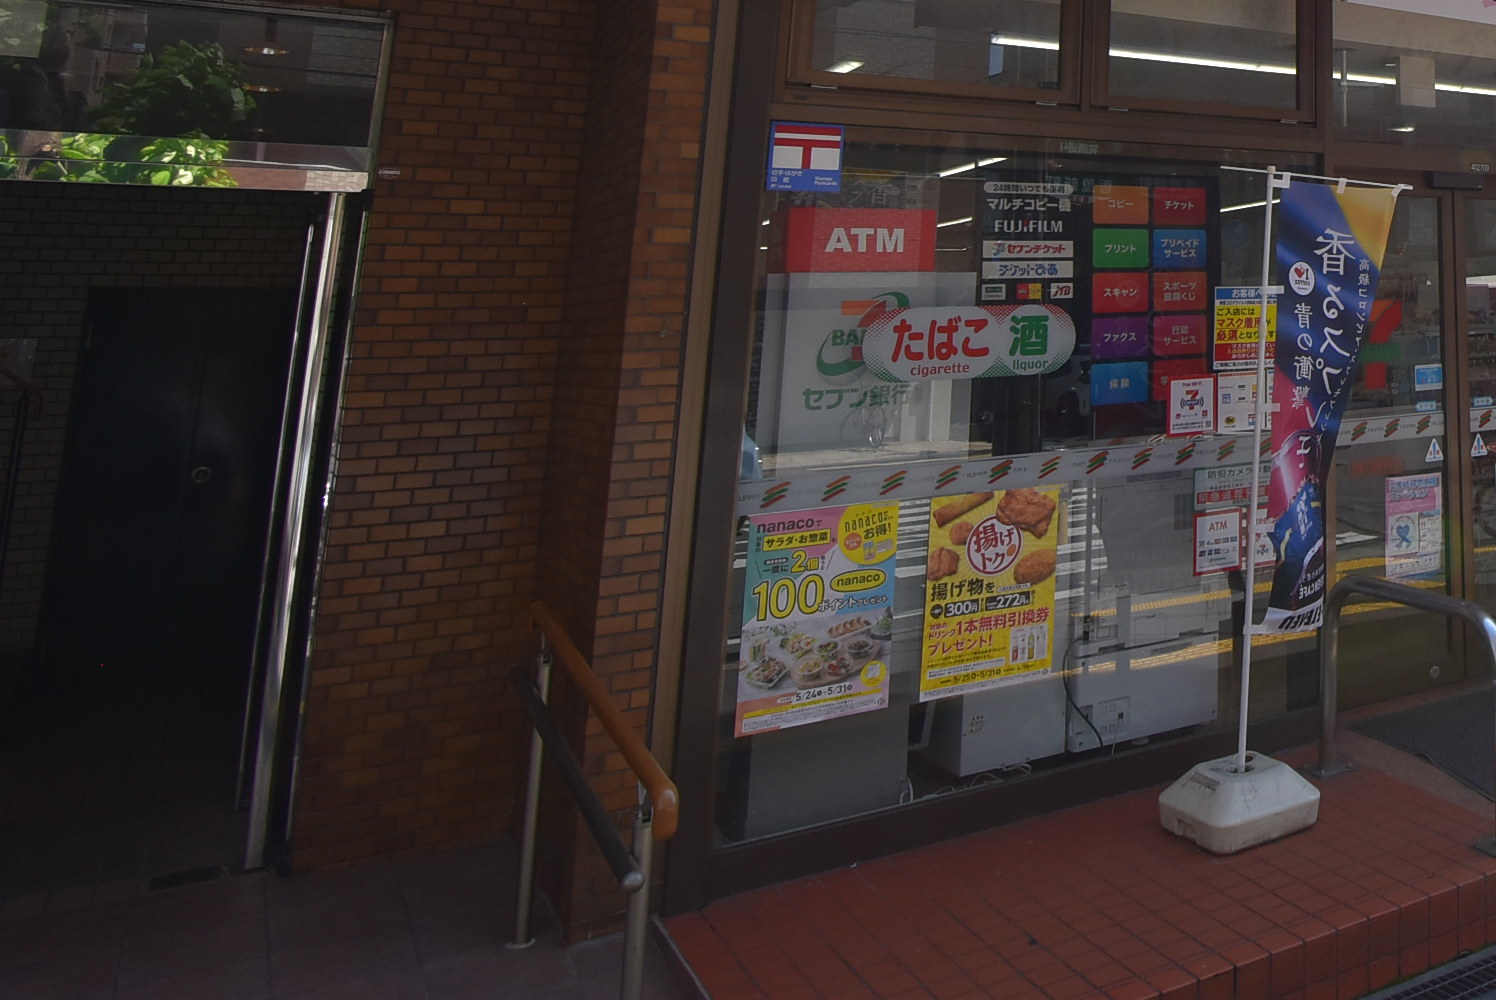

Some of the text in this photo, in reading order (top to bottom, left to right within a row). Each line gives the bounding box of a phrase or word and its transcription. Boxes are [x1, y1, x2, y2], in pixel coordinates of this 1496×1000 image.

[986, 197, 1072, 213] マルチコピー機
[1107, 199, 1134, 208] コピー
[1164, 200, 1195, 210] チケット
[824, 227, 905, 253] ATM
[1160, 238, 1199, 248] プリペイド
[1006, 243, 1066, 254] セブンチケット
[1104, 244, 1137, 253] プリント
[1164, 249, 1197, 258] サービス
[998, 263, 1058, 277] チケットぴあ
[1103, 287, 1138, 297] スキャン
[1162, 281, 1197, 290] スポーツ
[1216, 307, 1256, 316] ご入店には
[890, 314, 1050, 363] たばこ 酒
[1103, 332, 1137, 343] ファクス
[1163, 336, 1197, 346] サービス
[1216, 329, 1275, 341] 必須となりす
[910, 358, 1049, 378] cigarette liquor
[802, 383, 912, 411] セブン銀行
[863, 522, 892, 540] お得!
[1208, 520, 1228, 532] ATM
[765, 531, 829, 548] サラダ・お惣菜
[973, 522, 1015, 554] 揚げ
[980, 552, 1006, 571] トク
[836, 573, 881, 587] nanaco
[930, 577, 996, 602] 揚げ物を
[752, 573, 825, 622] 100
[945, 601, 978, 617] 300円
[996, 593, 1026, 609] 272円
[928, 629, 956, 640] ドリンク
[956, 607, 1050, 636] 1本無料引換券
[928, 634, 993, 657] プレゼント!
